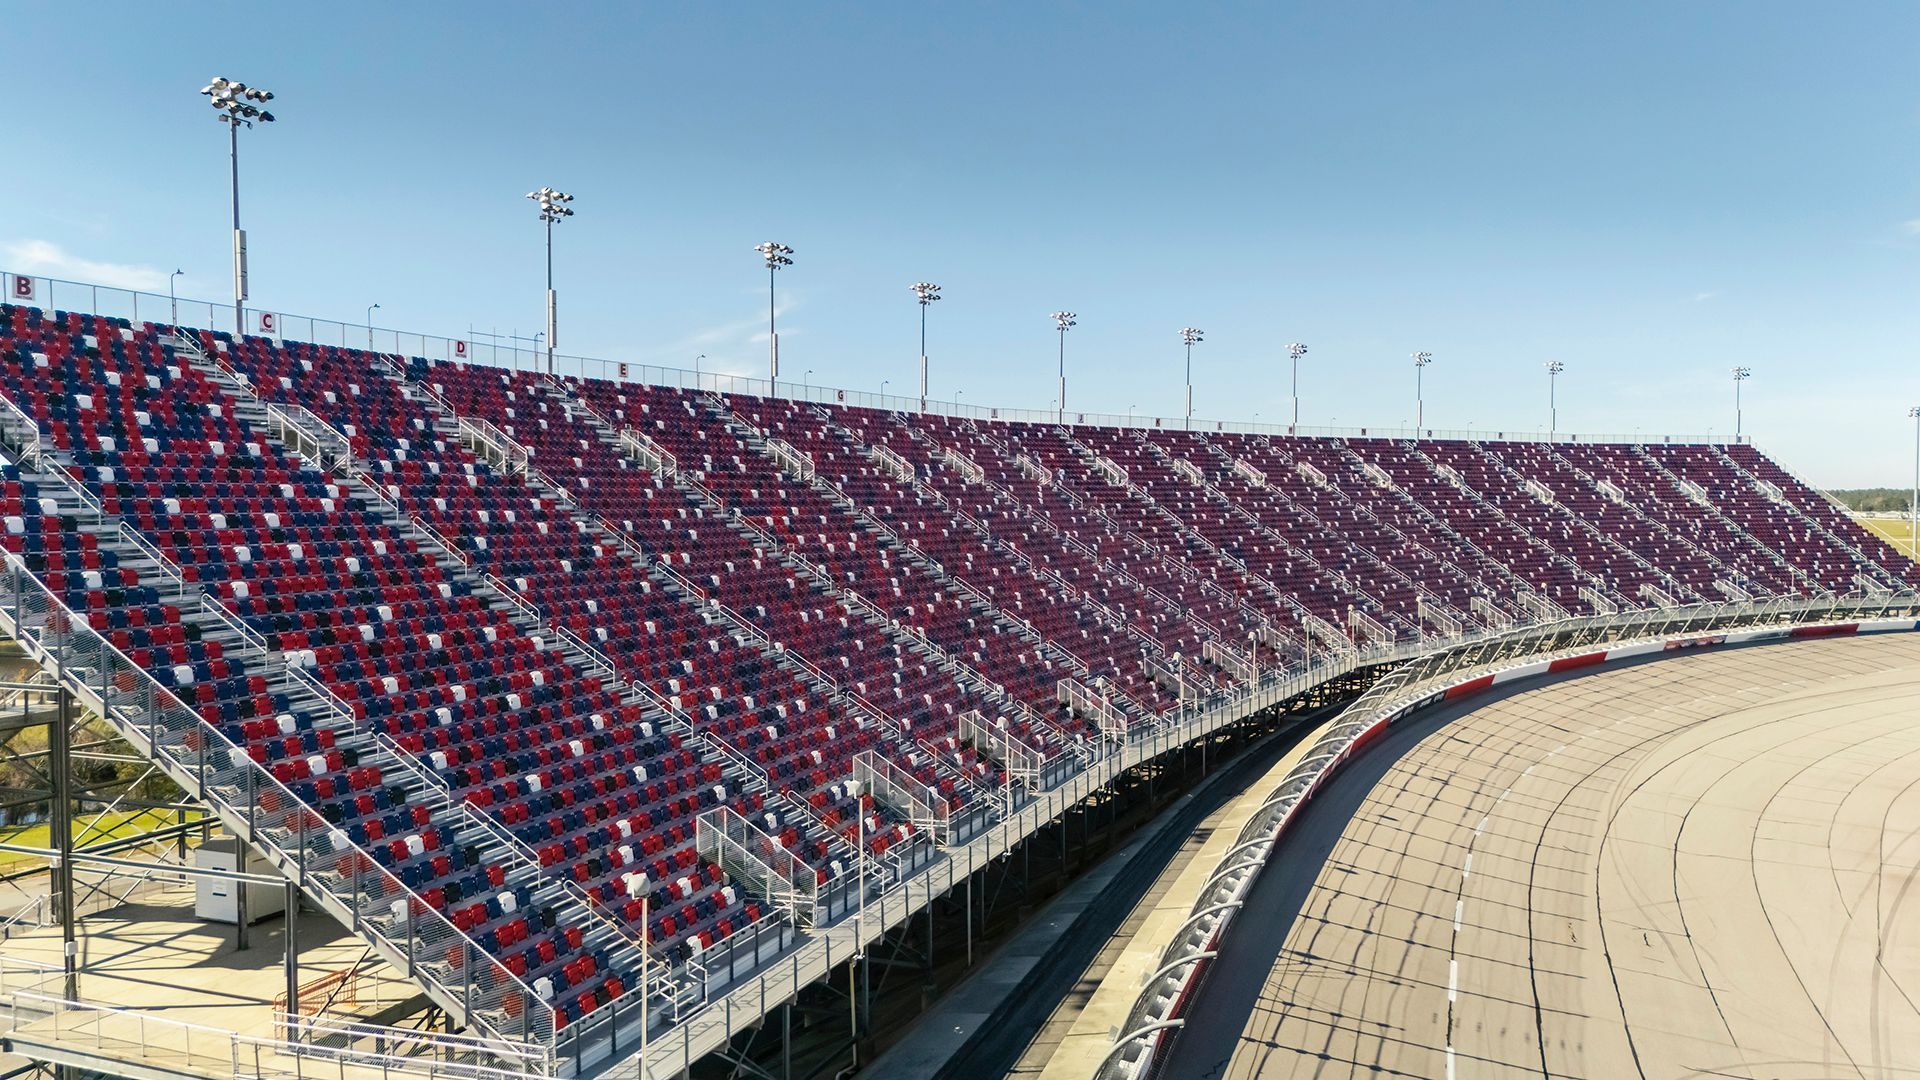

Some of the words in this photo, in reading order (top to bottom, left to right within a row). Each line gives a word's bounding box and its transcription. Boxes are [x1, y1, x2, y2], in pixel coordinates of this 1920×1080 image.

[16, 276, 31, 296] B
[263, 313, 272, 329] C
[457, 341, 465, 353] D
[620, 363, 626, 375] E
[838, 390, 844, 400] G
